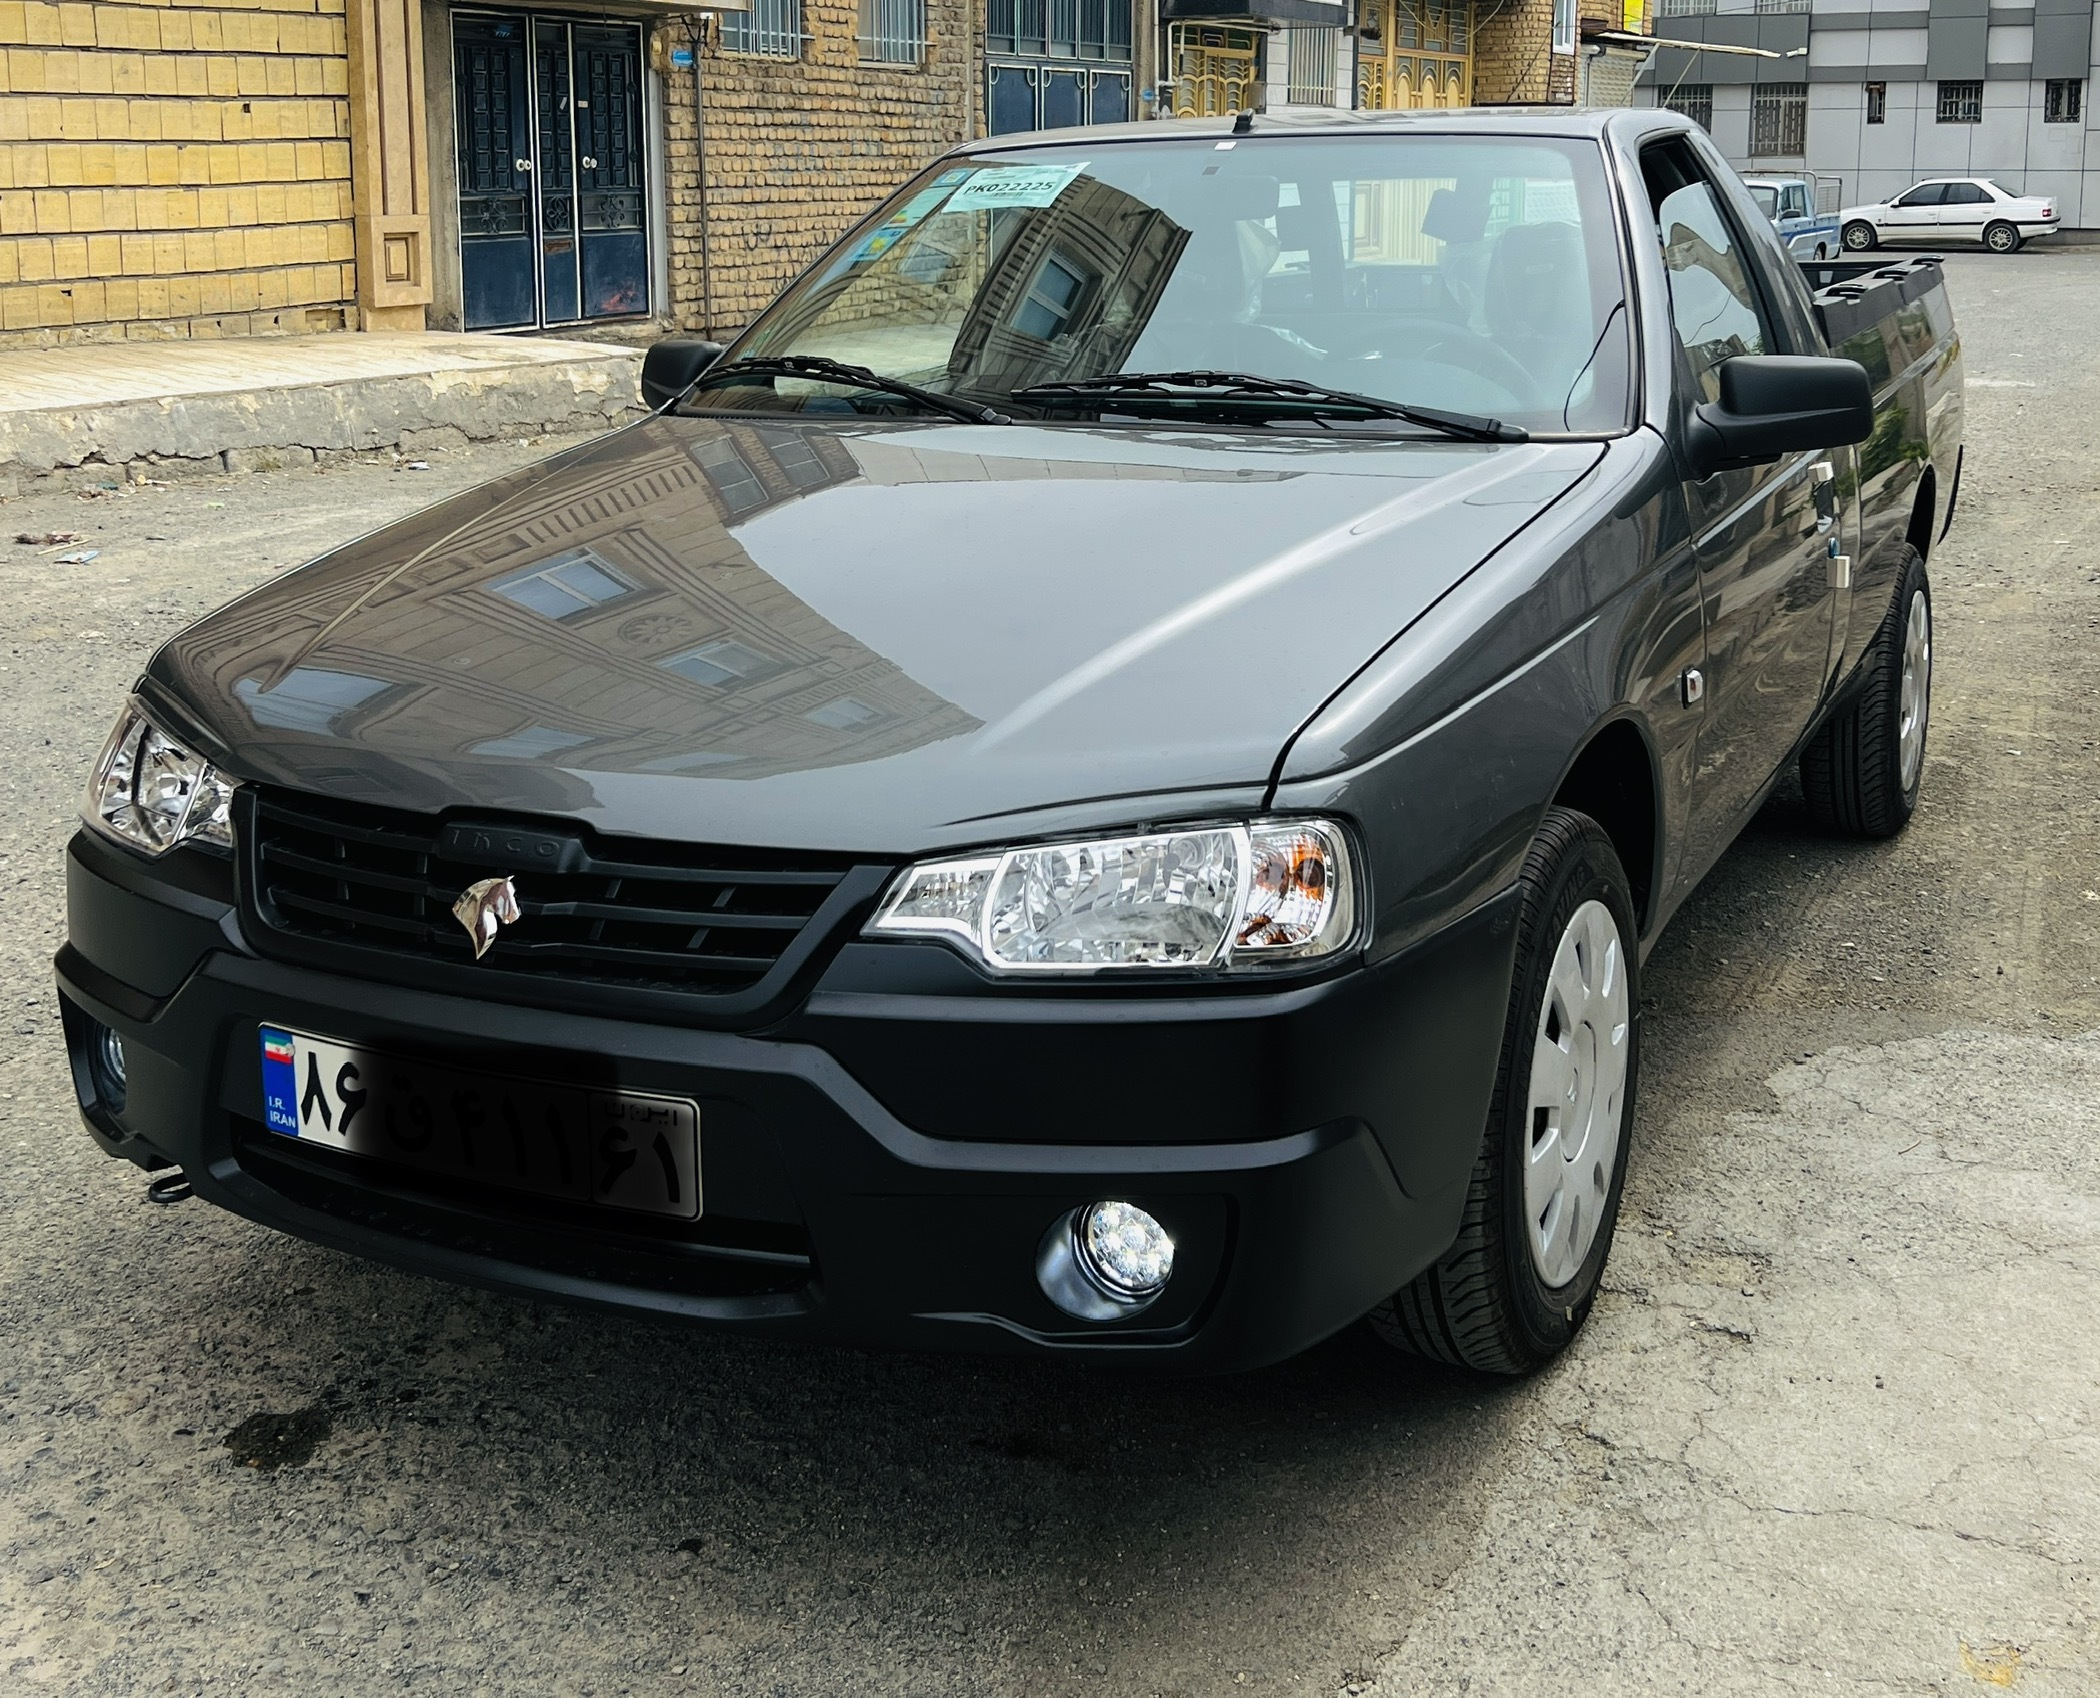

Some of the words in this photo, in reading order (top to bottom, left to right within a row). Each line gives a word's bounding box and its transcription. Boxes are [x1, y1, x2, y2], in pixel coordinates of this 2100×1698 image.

[963, 181, 1056, 196] PK022225
[268, 1096, 285, 1111] I.R.
[269, 1111, 297, 1129] IRAN
